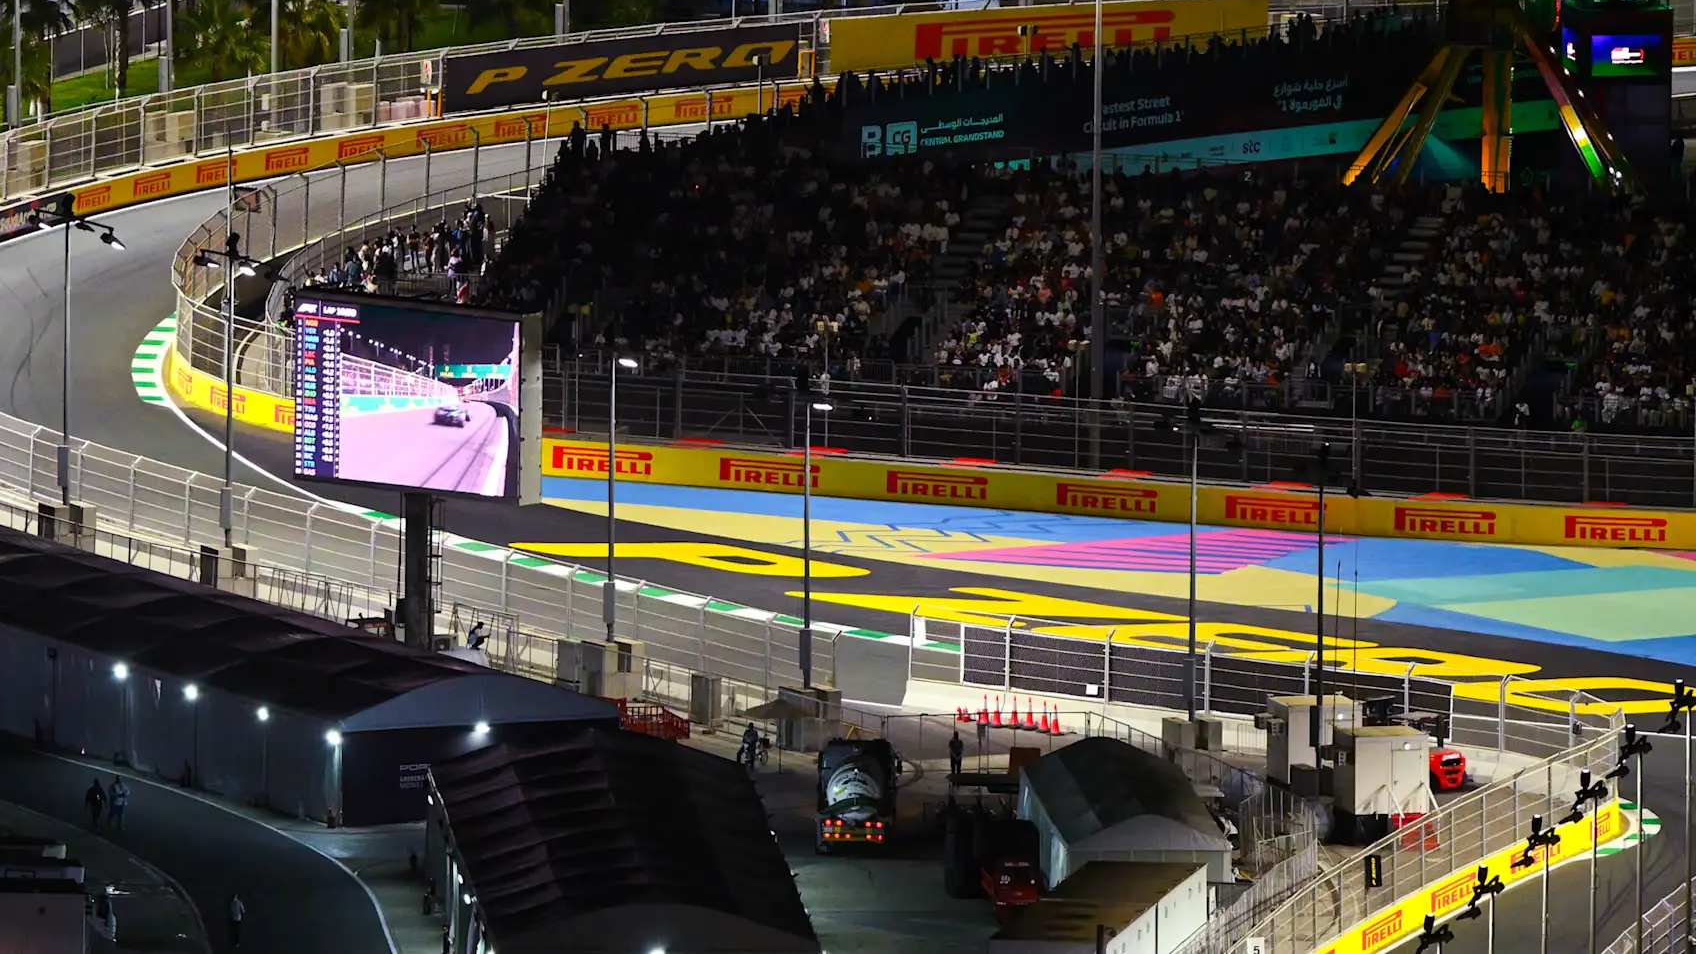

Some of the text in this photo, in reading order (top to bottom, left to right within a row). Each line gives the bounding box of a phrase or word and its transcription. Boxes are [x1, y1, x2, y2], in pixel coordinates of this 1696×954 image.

[914, 10, 1176, 60] PIRELLI
[466, 40, 795, 95] P ZERO
[675, 96, 734, 118] PIRELLI
[1136, 95, 1171, 111] Street
[1119, 118, 1129, 130] in
[1130, 112, 1174, 128] Formula
[920, 129, 1004, 146] CENTRAL GRANDSTAND
[1242, 139, 1261, 154] stc
[265, 146, 309, 171] PIRELLI
[133, 172, 171, 198] PIRELLI
[1244, 171, 1252, 182] 2
[77, 186, 111, 211] PIRELLI
[305, 319, 318, 327] NOR
[305, 327, 316, 335] VER
[305, 343, 316, 351] PER
[305, 350, 316, 358] LEC
[305, 358, 315, 366] PIA
[305, 366, 316, 374] ALO
[552, 445, 653, 476] PIRELLI
[719, 457, 821, 489] PIRELLI
[886, 469, 988, 501] PIRELLI
[1056, 482, 1158, 513] PIRELLI
[1225, 495, 1327, 524] PIRELLI
[1394, 507, 1496, 536] PIRELLI
[1564, 515, 1667, 543] PIRELLI
[1362, 910, 1403, 951] PIRELLI
